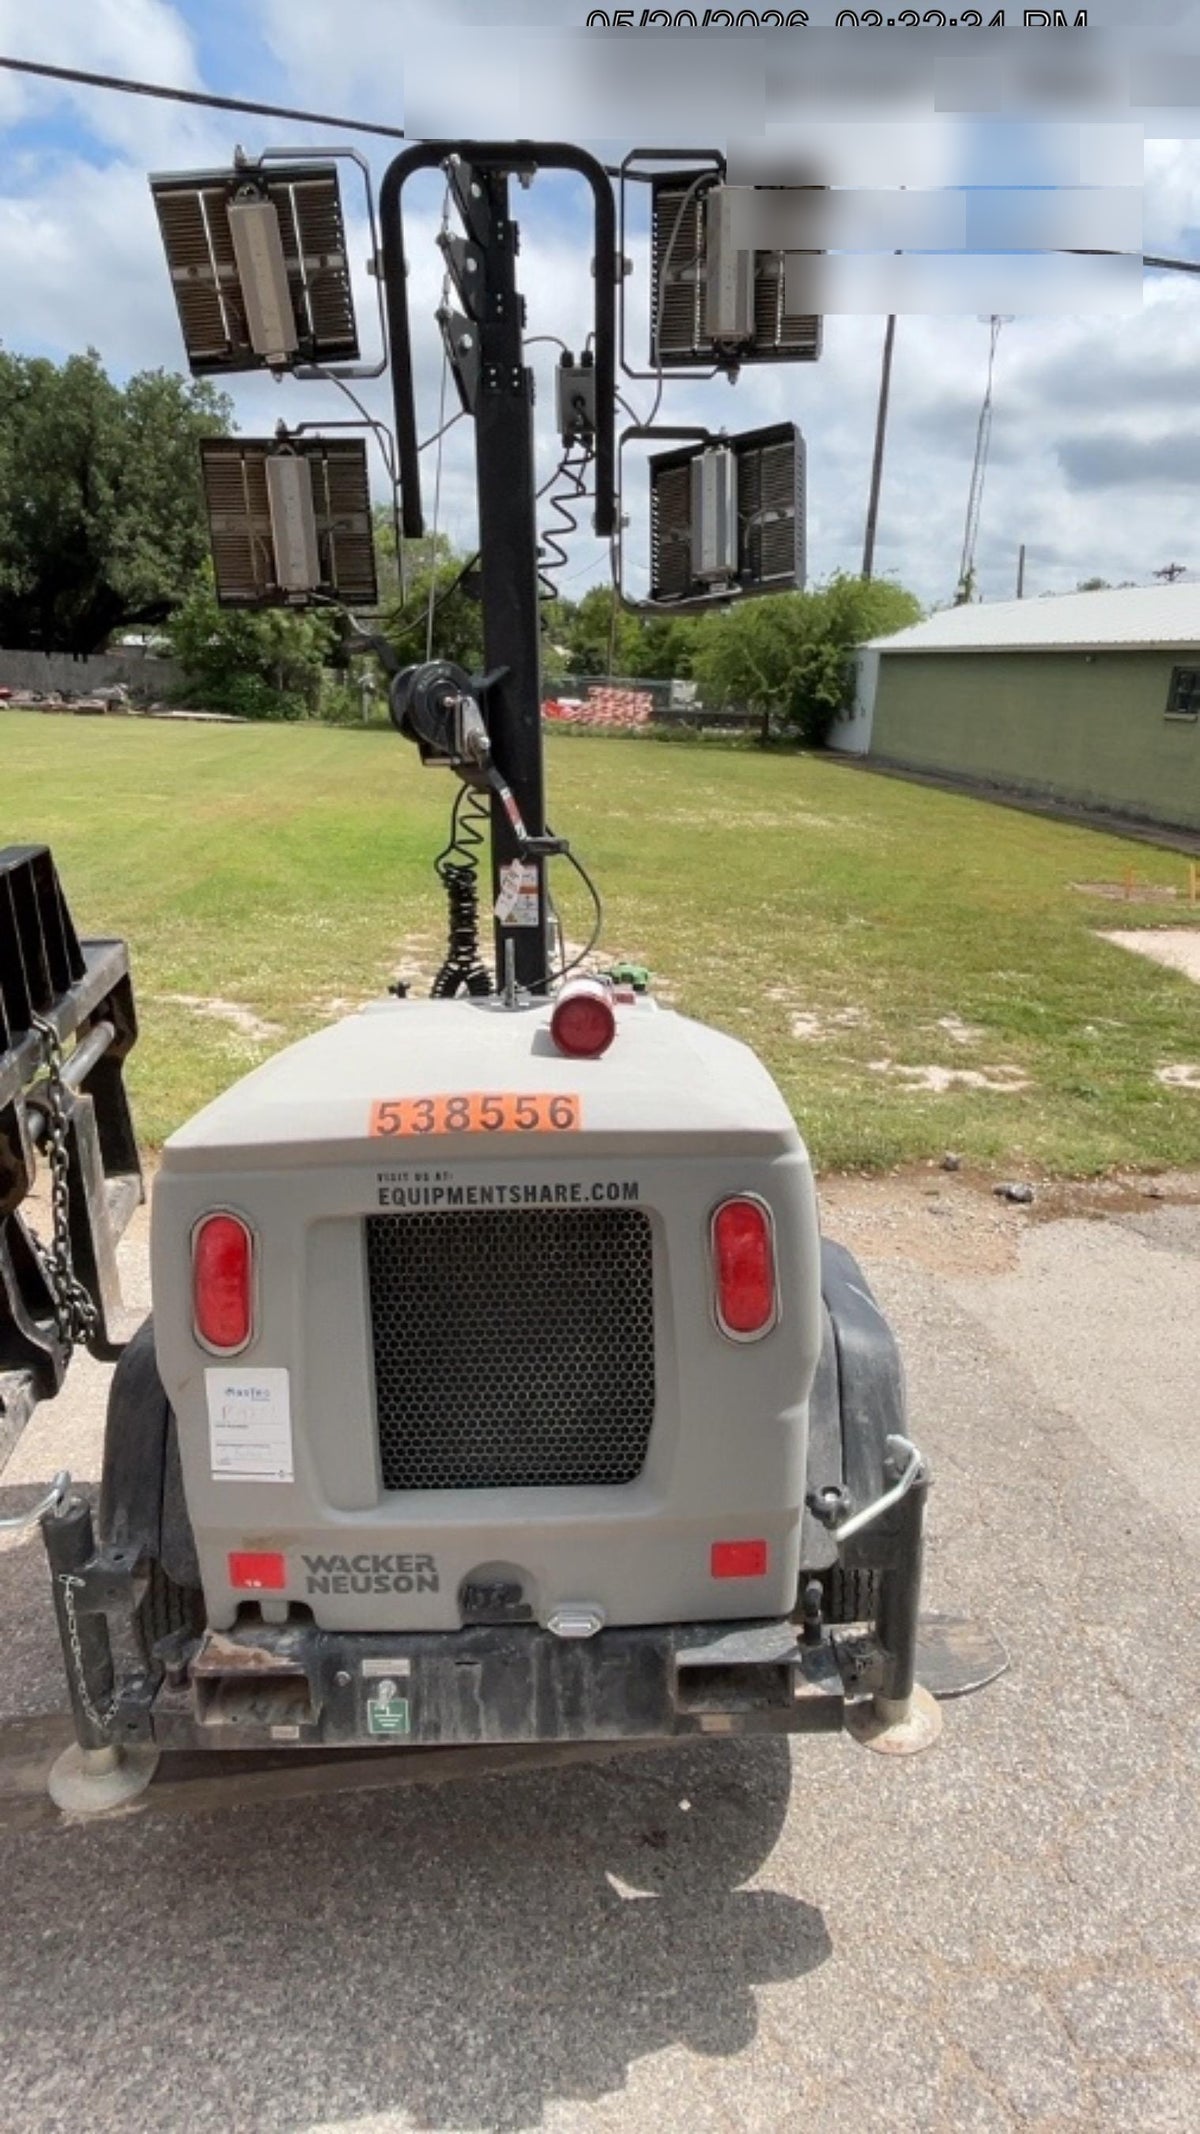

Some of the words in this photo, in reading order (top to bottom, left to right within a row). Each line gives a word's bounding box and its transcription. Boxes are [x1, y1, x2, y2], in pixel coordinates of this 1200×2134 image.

[376, 1095, 576, 1136] 538556
[378, 1182, 639, 1207] EQUIPMENTSHARE.COM
[302, 1554, 437, 1574] WACKER
[306, 1574, 439, 1595] NEUSON
